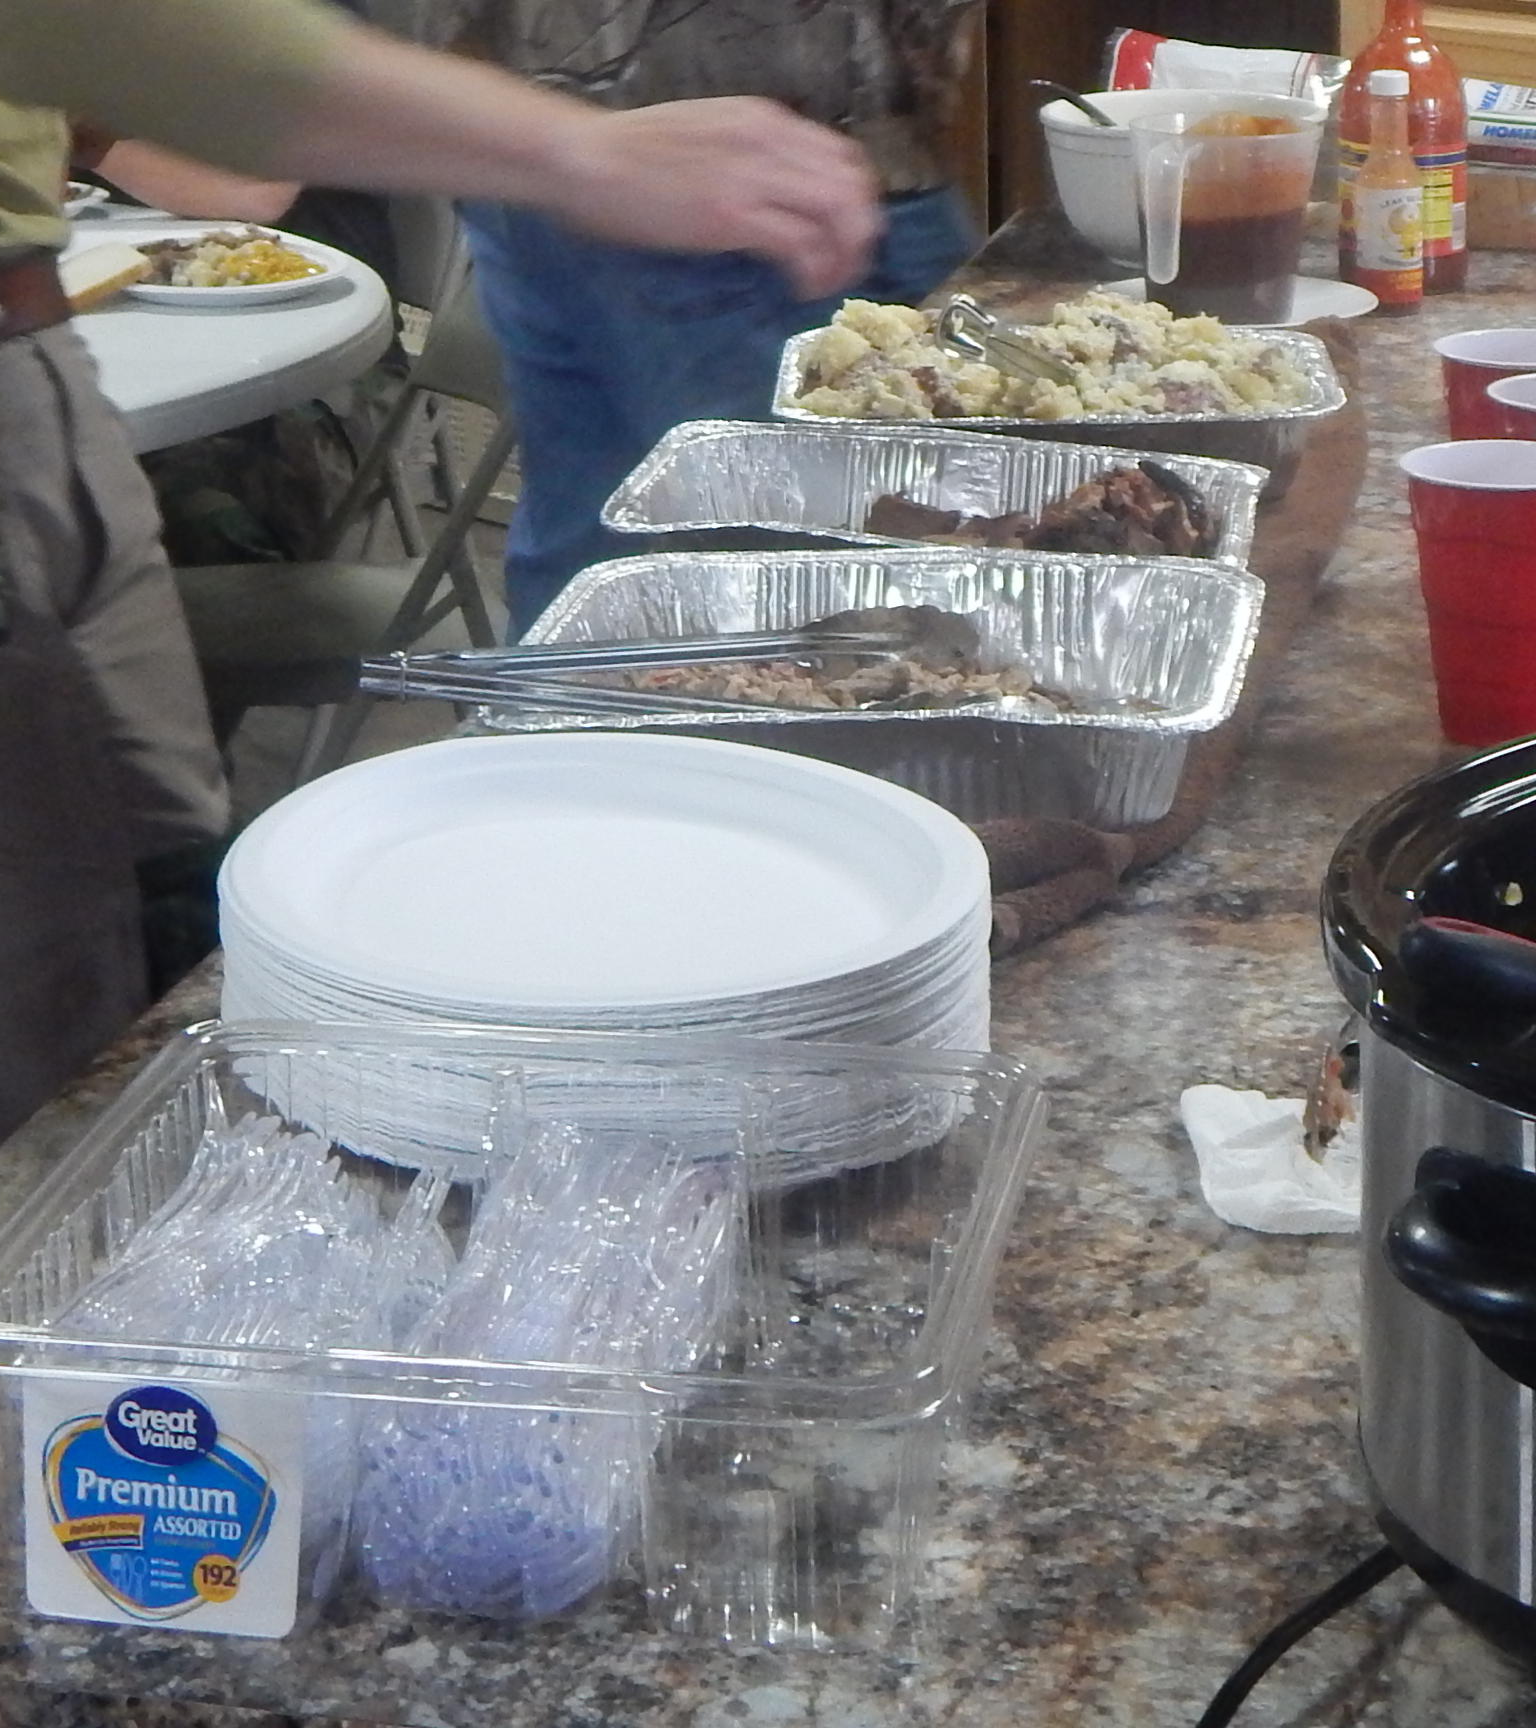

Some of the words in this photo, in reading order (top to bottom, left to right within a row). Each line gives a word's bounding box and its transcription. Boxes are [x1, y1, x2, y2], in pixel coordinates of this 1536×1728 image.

[118, 1401, 197, 1435] Great
[136, 1430, 197, 1451] Value
[75, 1467, 238, 1516] Premium
[153, 1514, 242, 1541] ASSORTED
[199, 1564, 237, 1587] 192
